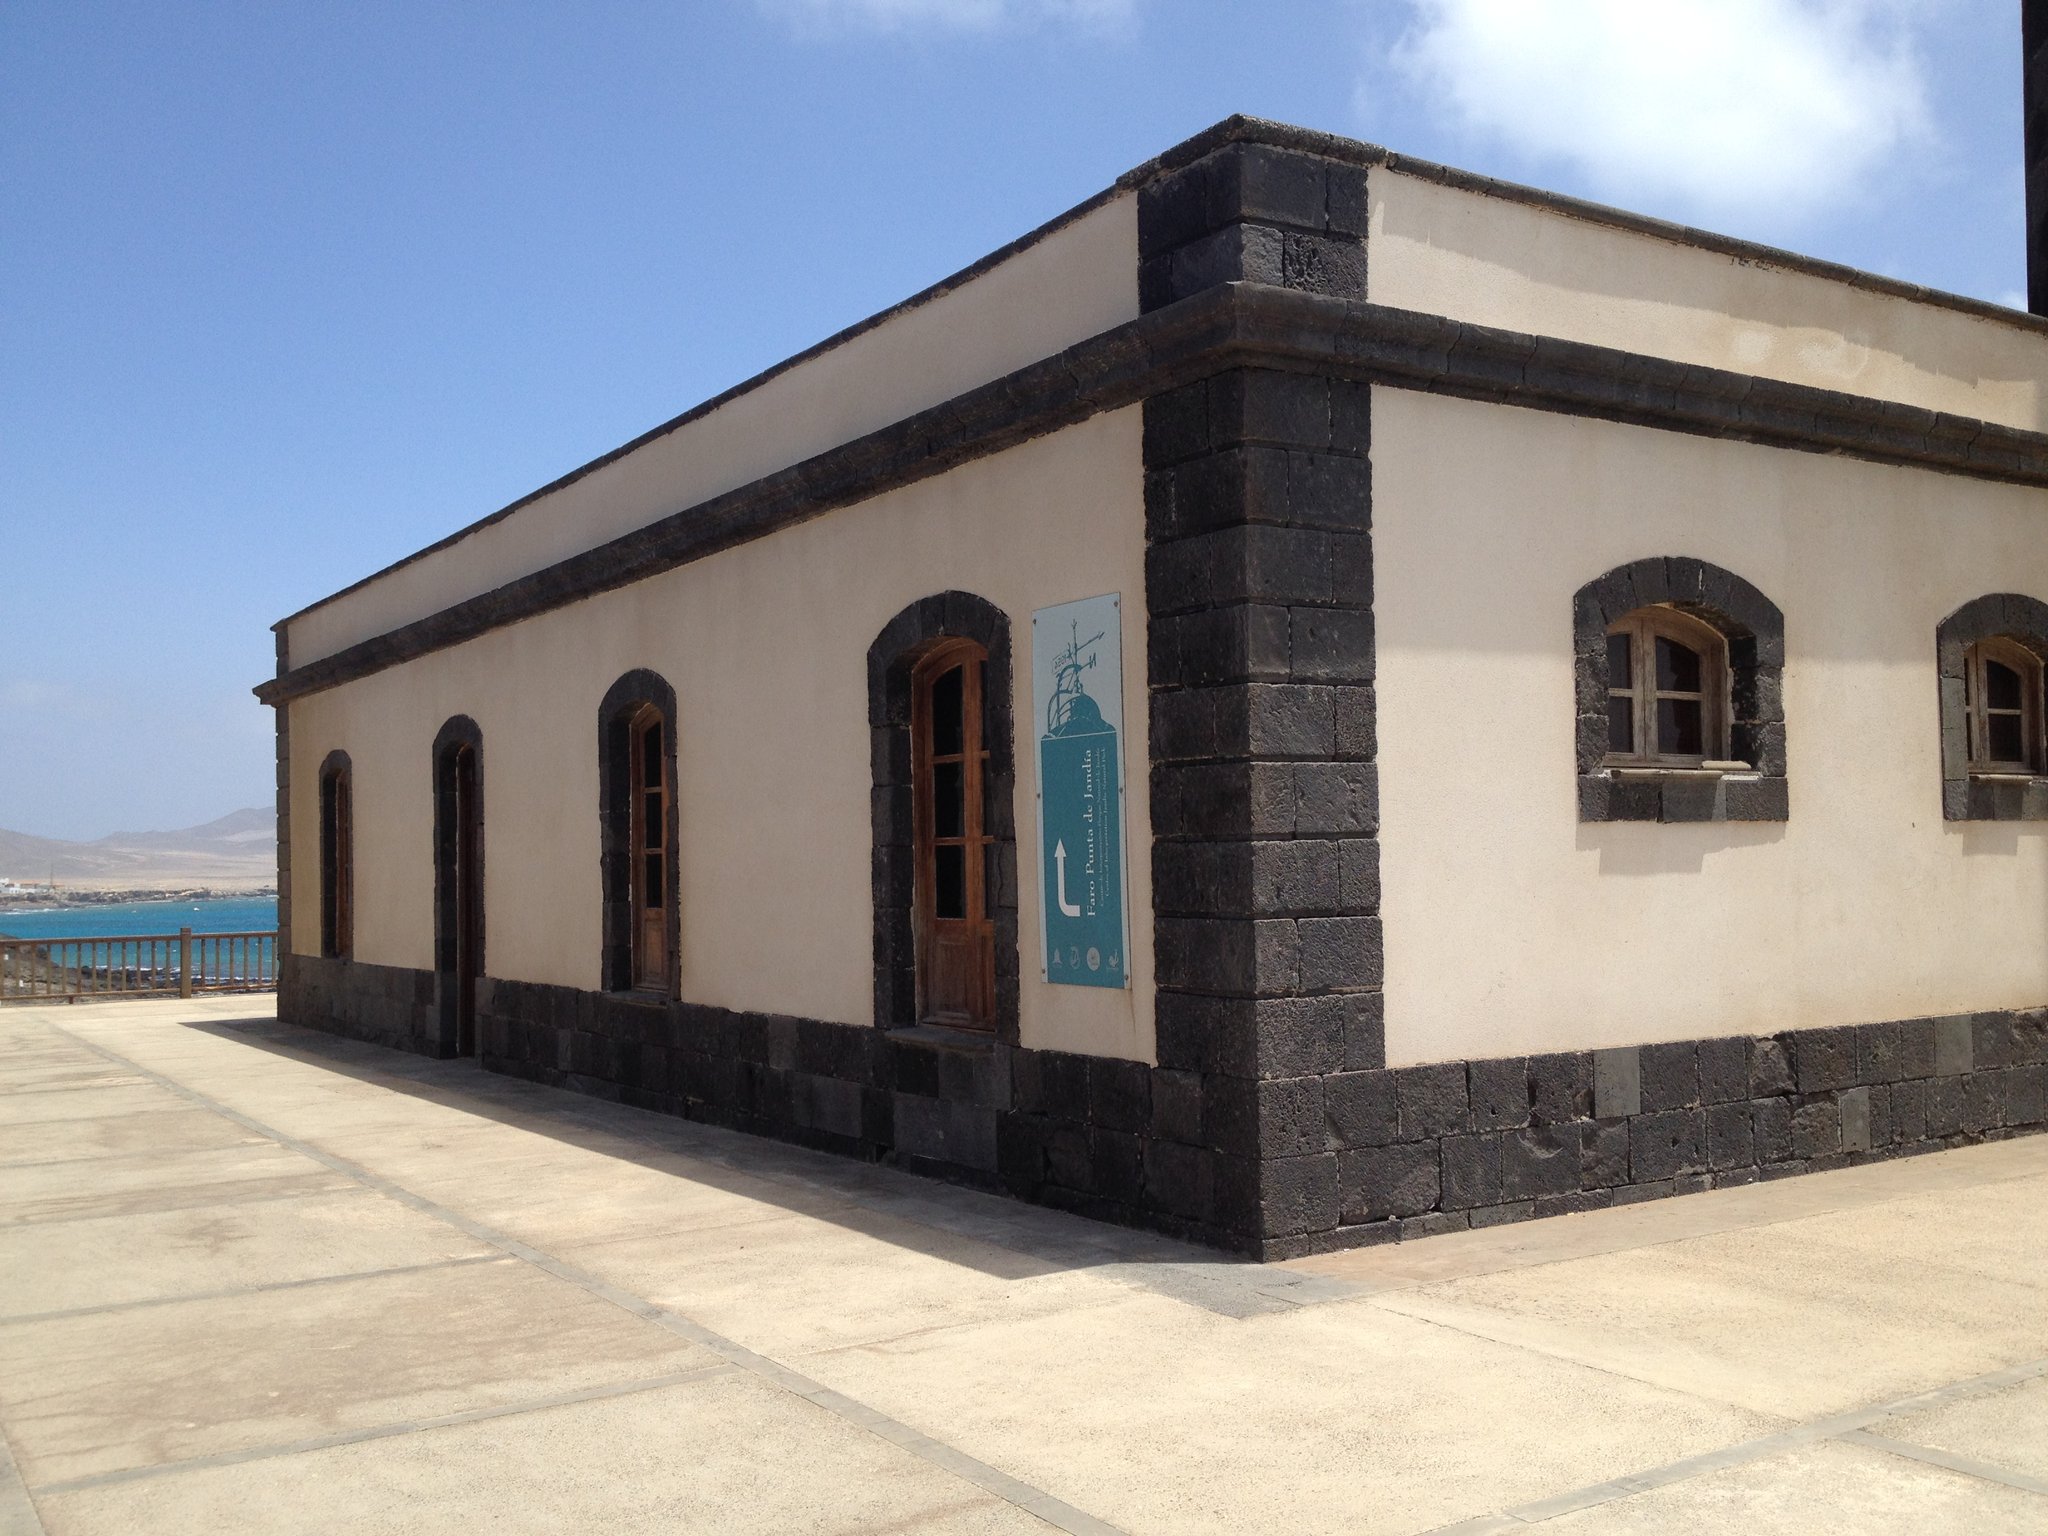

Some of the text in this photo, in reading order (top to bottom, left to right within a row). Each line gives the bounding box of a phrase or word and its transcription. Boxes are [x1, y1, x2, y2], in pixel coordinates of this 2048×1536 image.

[1081, 749, 1096, 915] Faro Punta de Jandía
